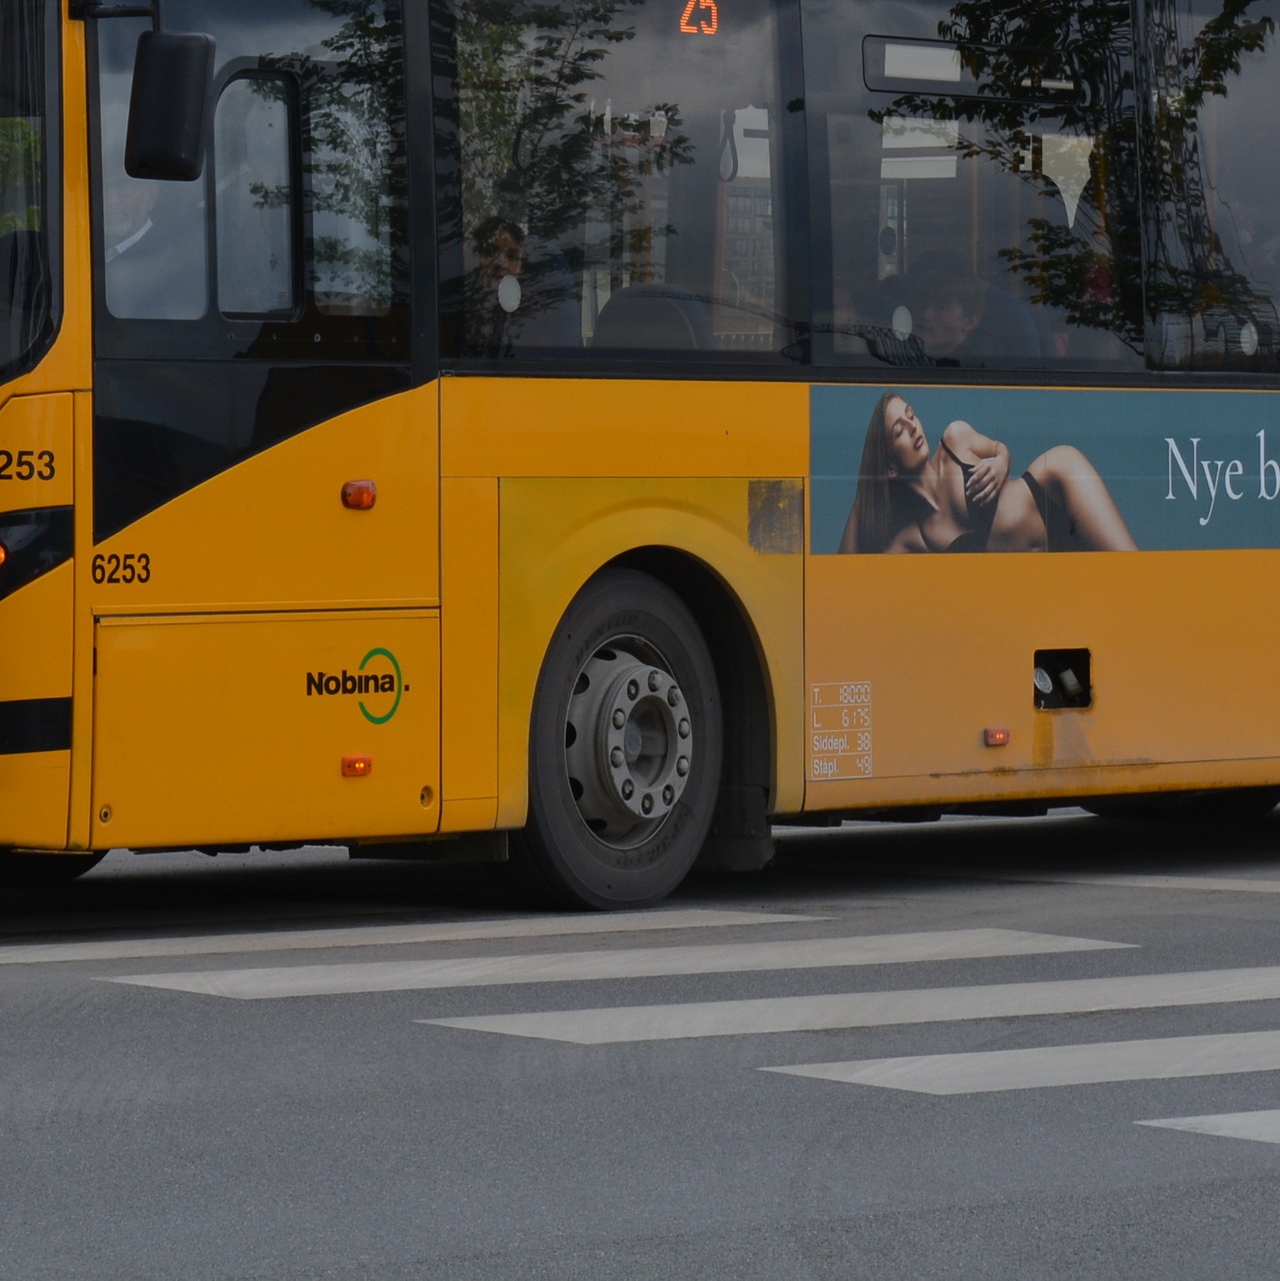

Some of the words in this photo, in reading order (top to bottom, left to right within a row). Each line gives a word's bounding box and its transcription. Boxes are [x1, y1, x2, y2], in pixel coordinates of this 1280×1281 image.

[1164, 437, 1244, 526] Nye
[91, 553, 151, 585] 6253
[306, 669, 395, 696] Nobina
[839, 684, 870, 704] 18000
[813, 734, 850, 755] Siddepl.
[857, 732, 870, 751] 38
[813, 758, 839, 778] Ståpl.
